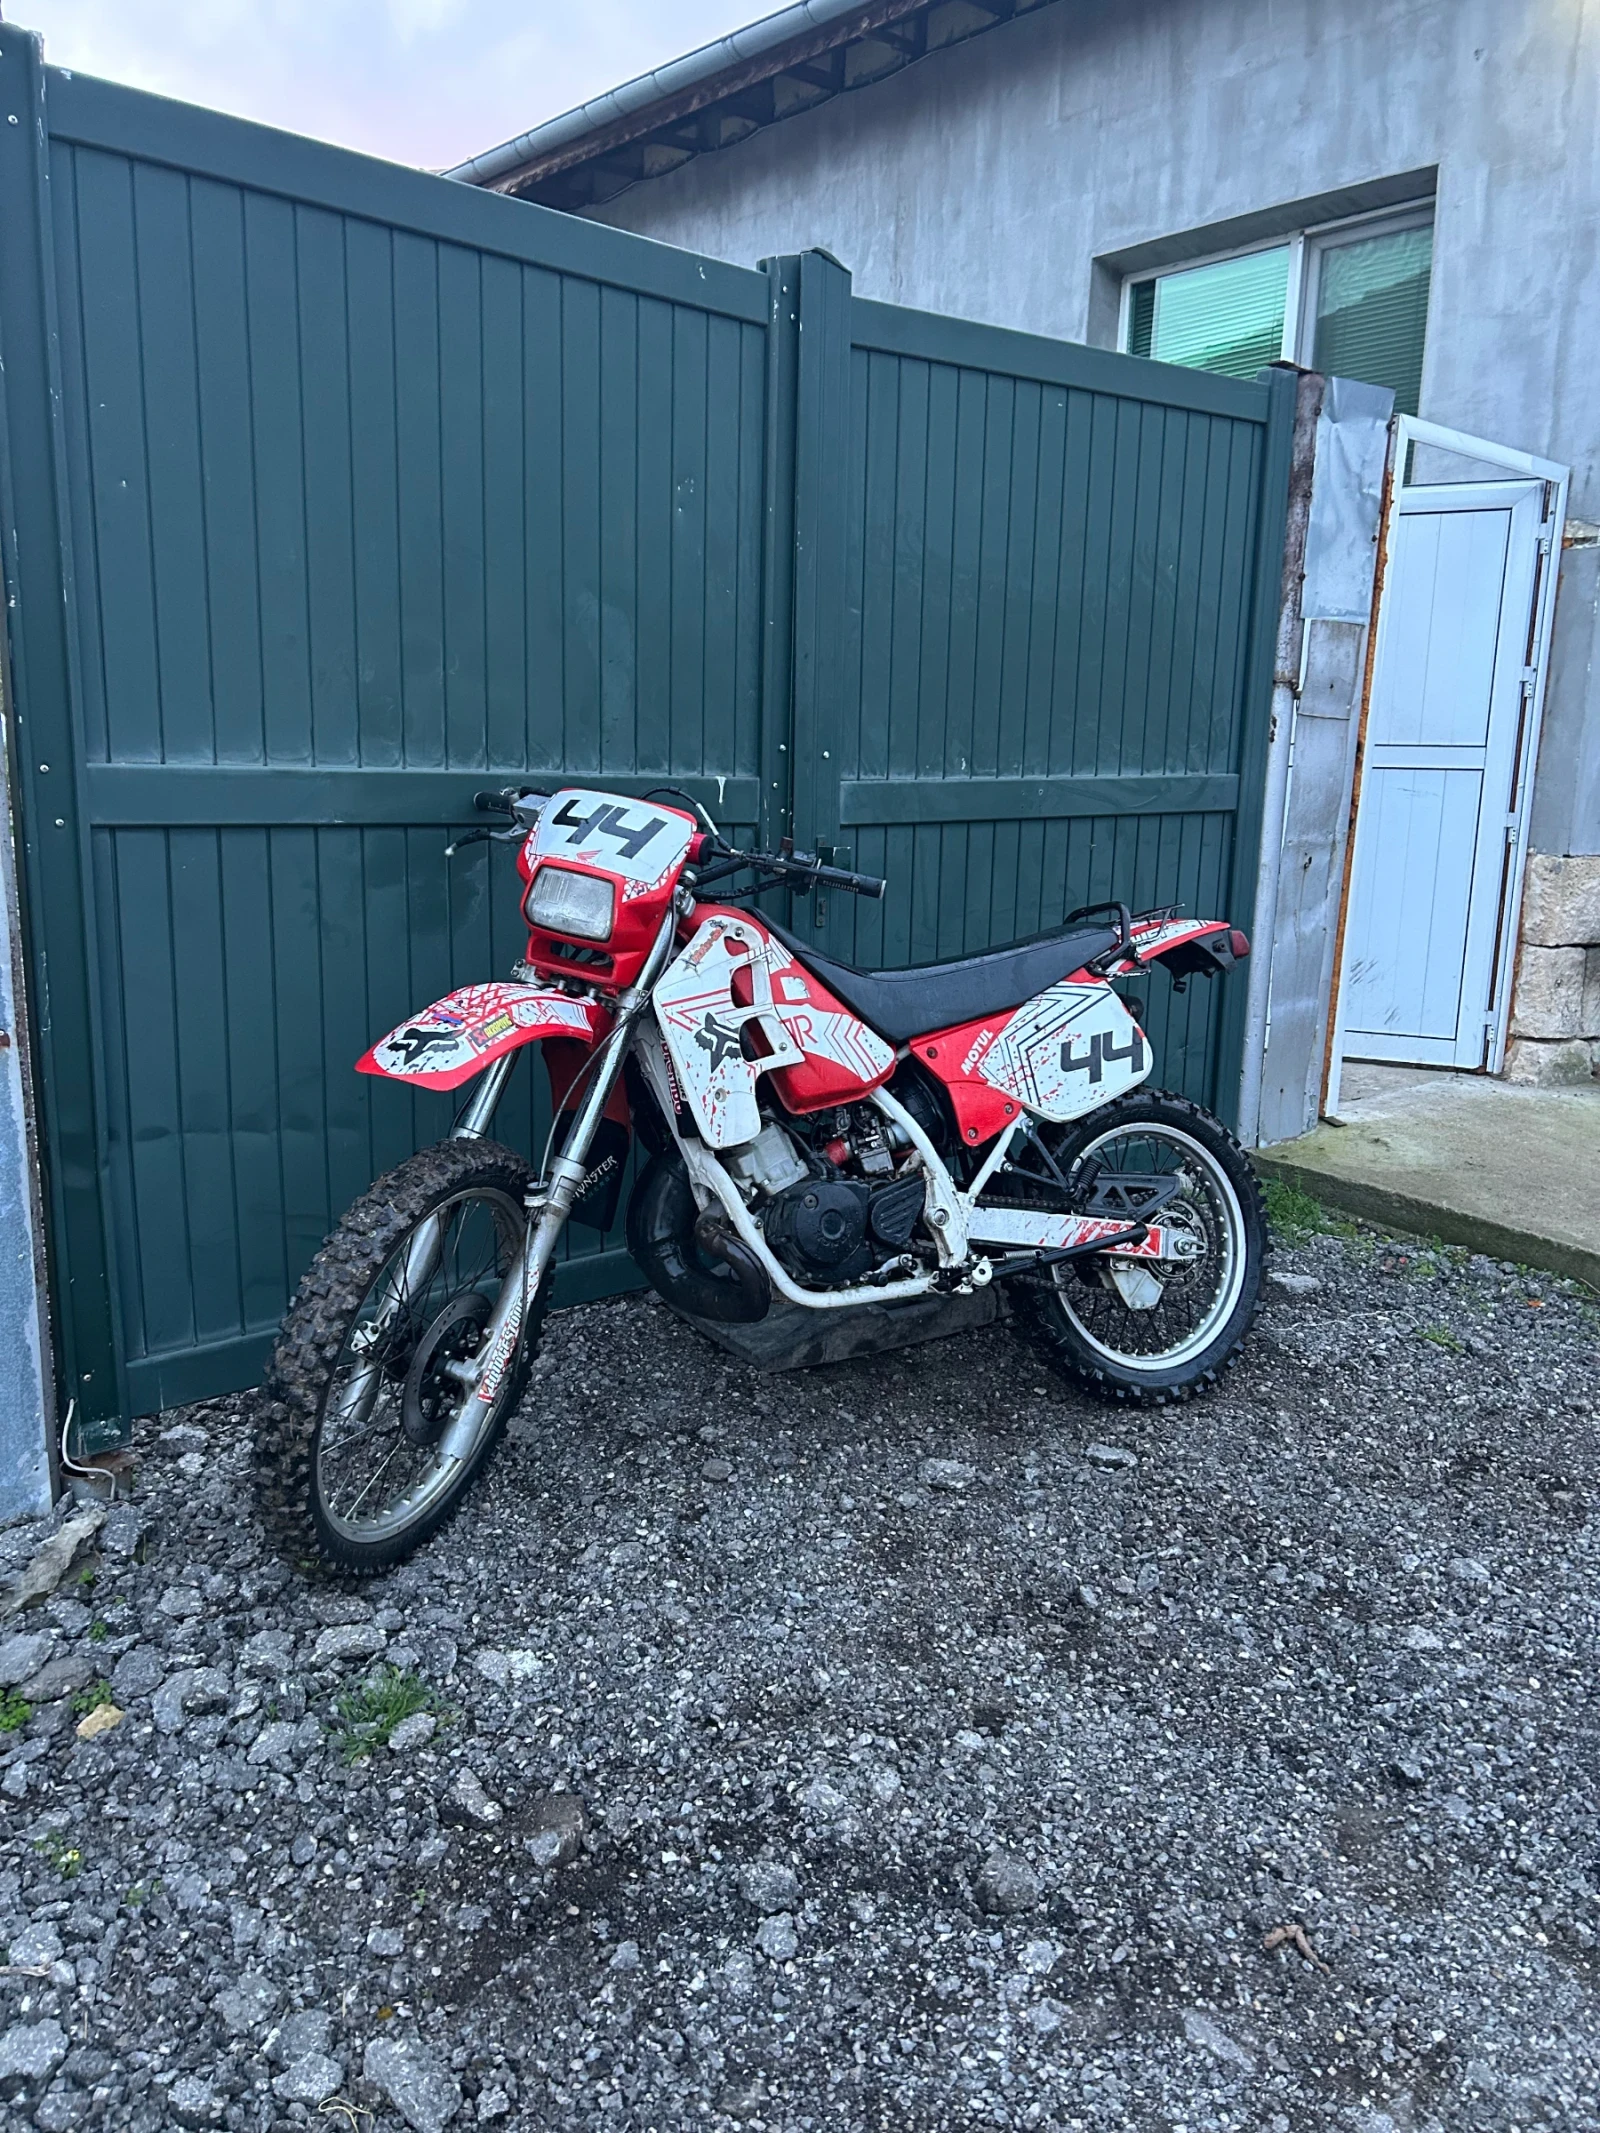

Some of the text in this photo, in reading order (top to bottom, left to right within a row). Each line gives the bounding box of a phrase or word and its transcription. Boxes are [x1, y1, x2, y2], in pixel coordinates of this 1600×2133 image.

[552, 799, 668, 860] 44
[960, 1028, 994, 1076] MOTUL
[1060, 1026, 1144, 1084] 44
